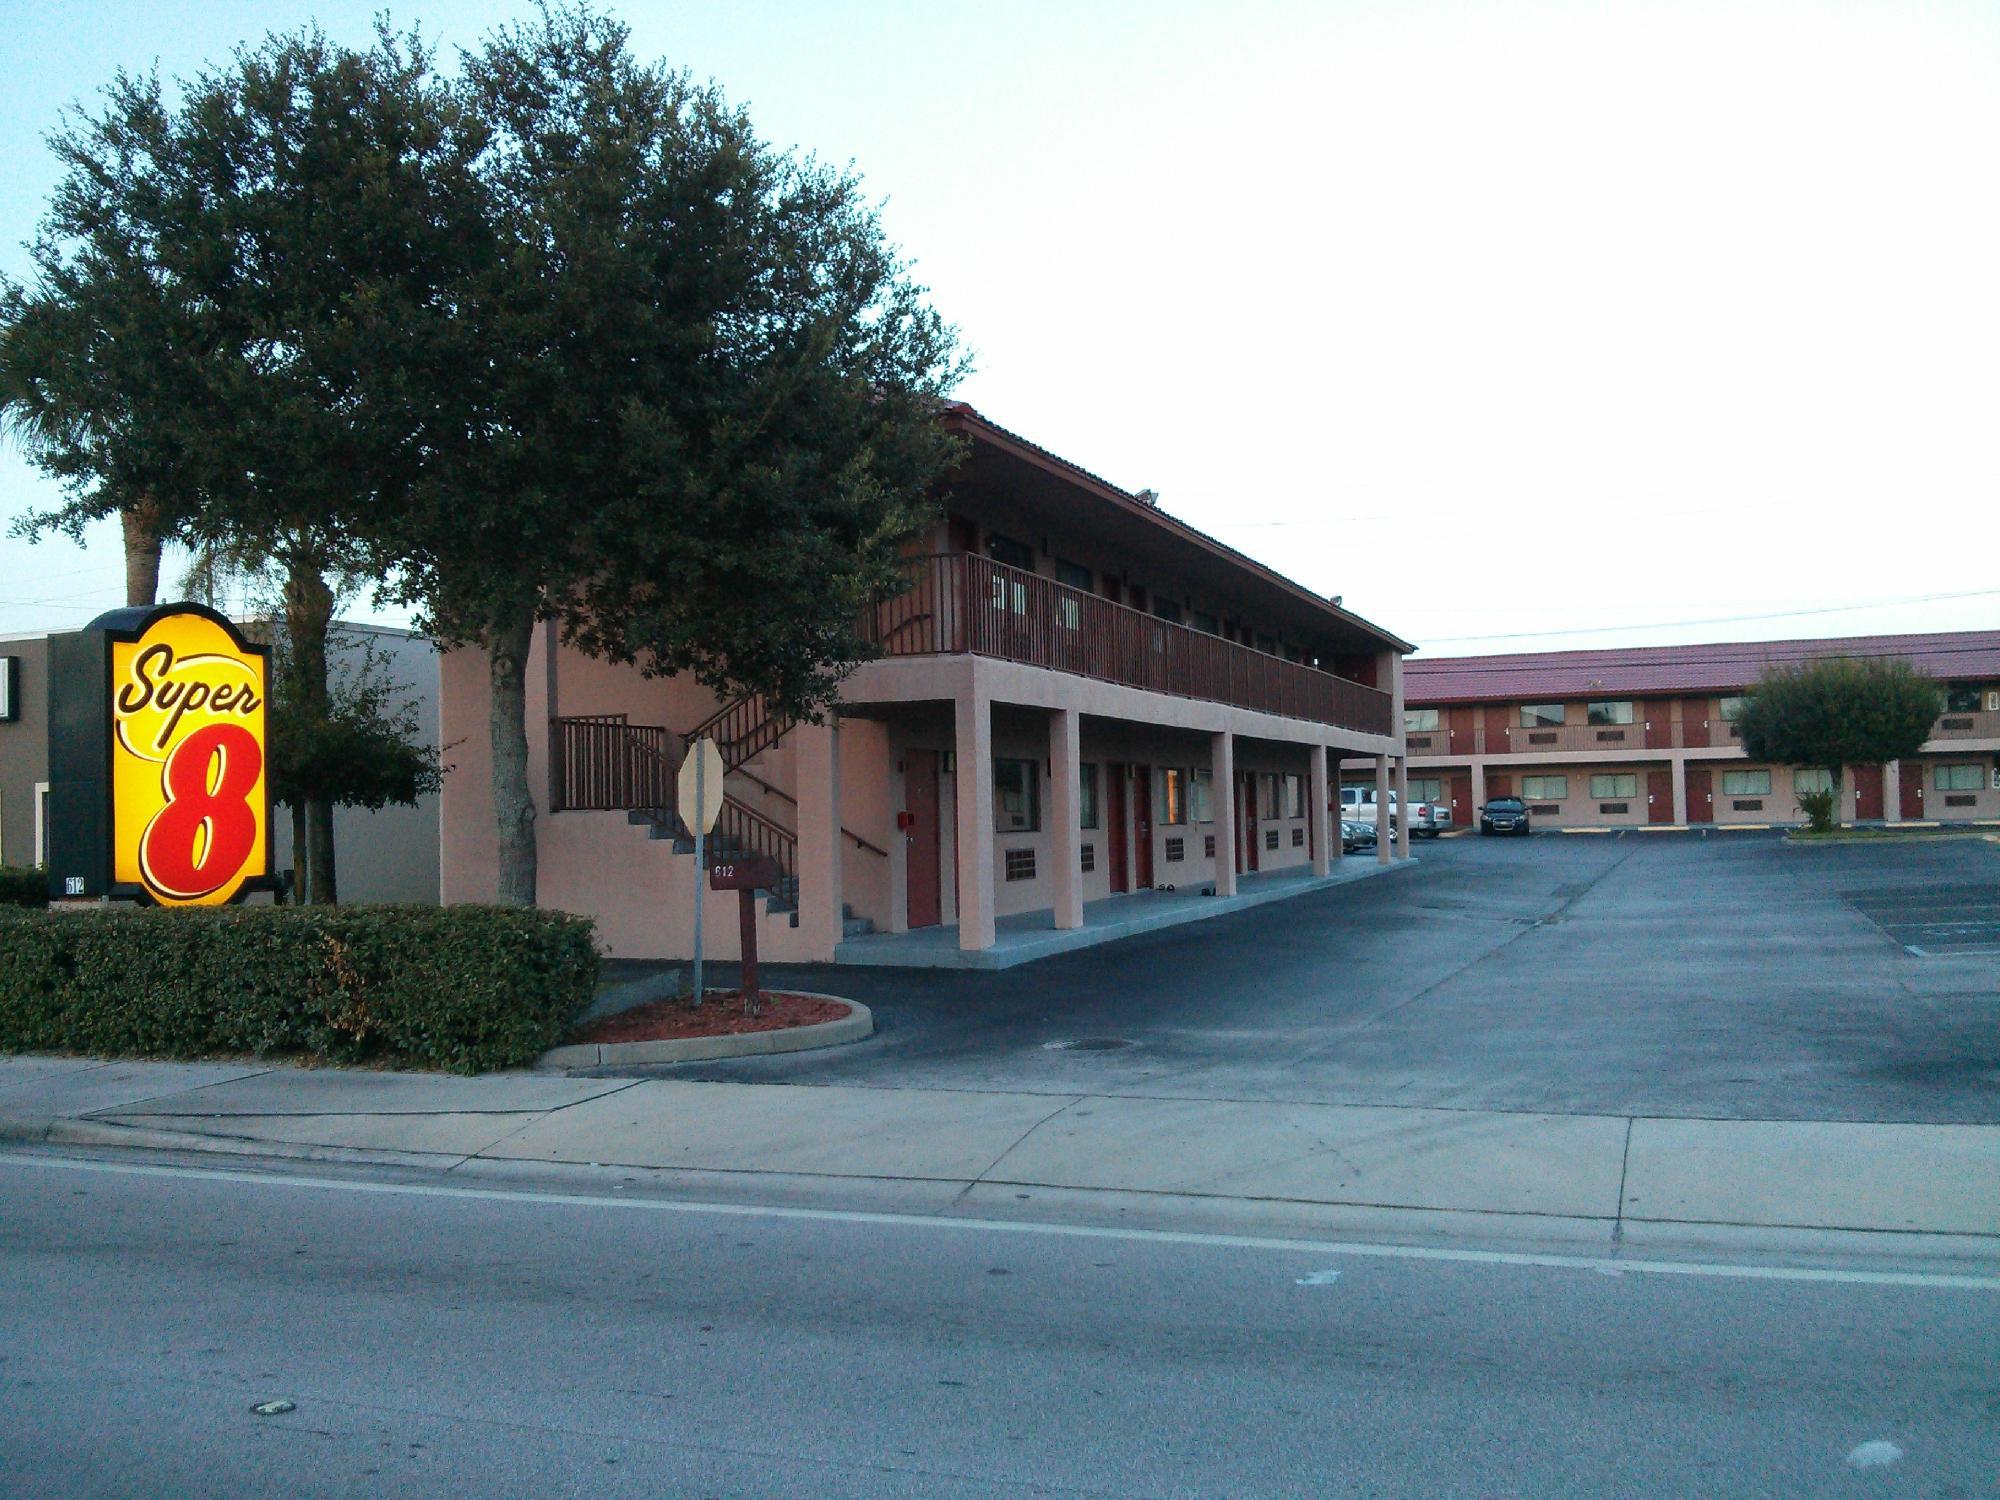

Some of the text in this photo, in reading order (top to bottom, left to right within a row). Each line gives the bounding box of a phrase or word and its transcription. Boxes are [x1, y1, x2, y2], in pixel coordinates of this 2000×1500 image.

[118, 643, 262, 749] Super
[139, 722, 262, 899] 8
[66, 877, 84, 894] 612
[715, 865, 734, 877] 612
